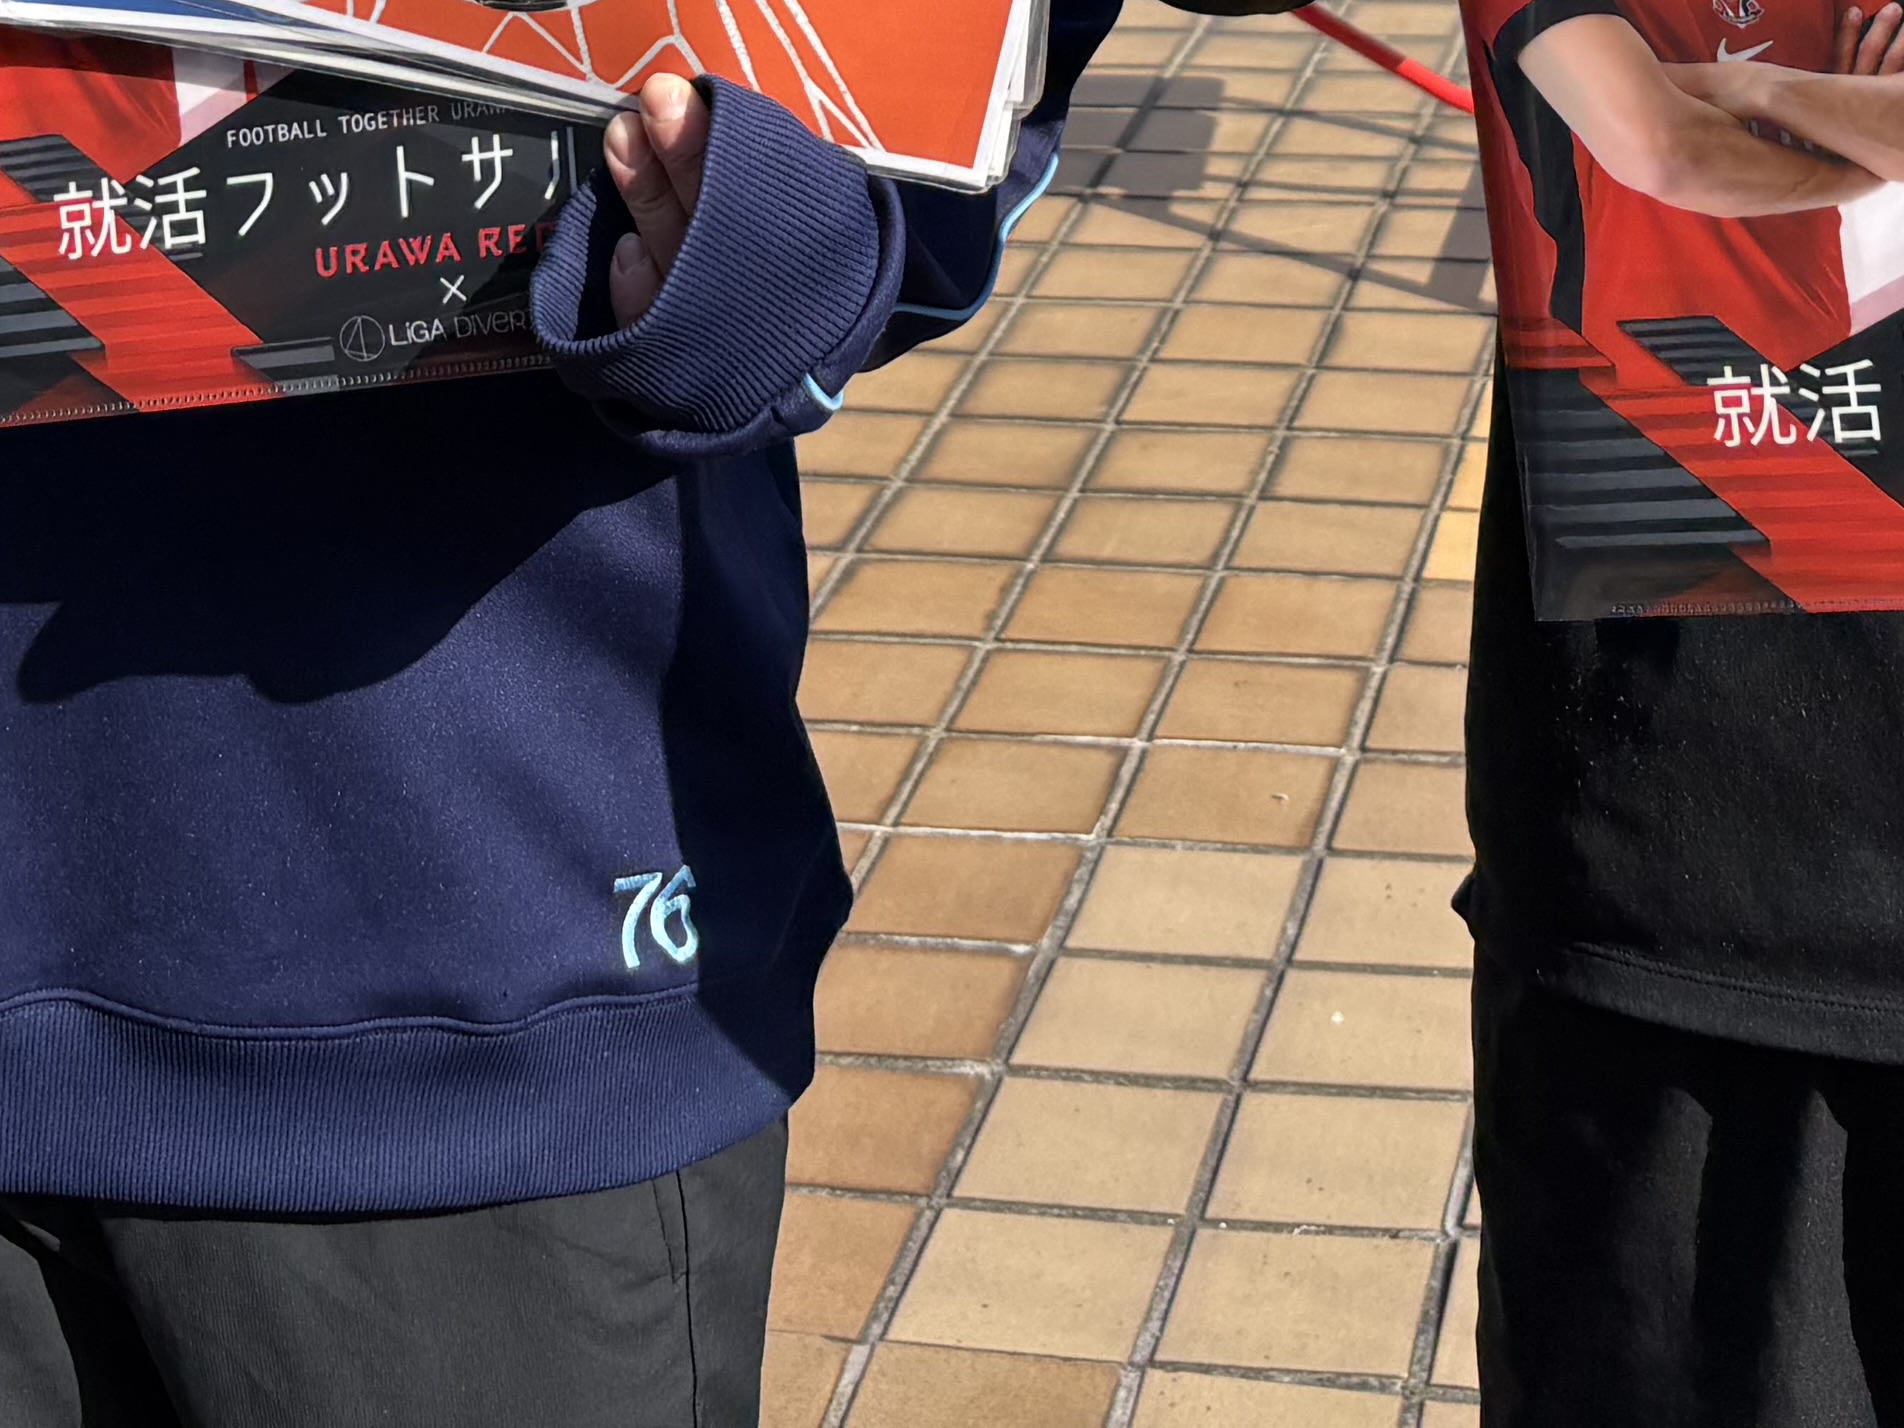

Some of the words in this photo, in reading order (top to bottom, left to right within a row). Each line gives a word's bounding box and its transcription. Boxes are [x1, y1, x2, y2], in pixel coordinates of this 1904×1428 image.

[226, 118, 328, 149] FOOTBALL
[337, 103, 441, 136] TOGETHER
[315, 231, 461, 279] URAWA
[613, 864, 700, 969] 76
